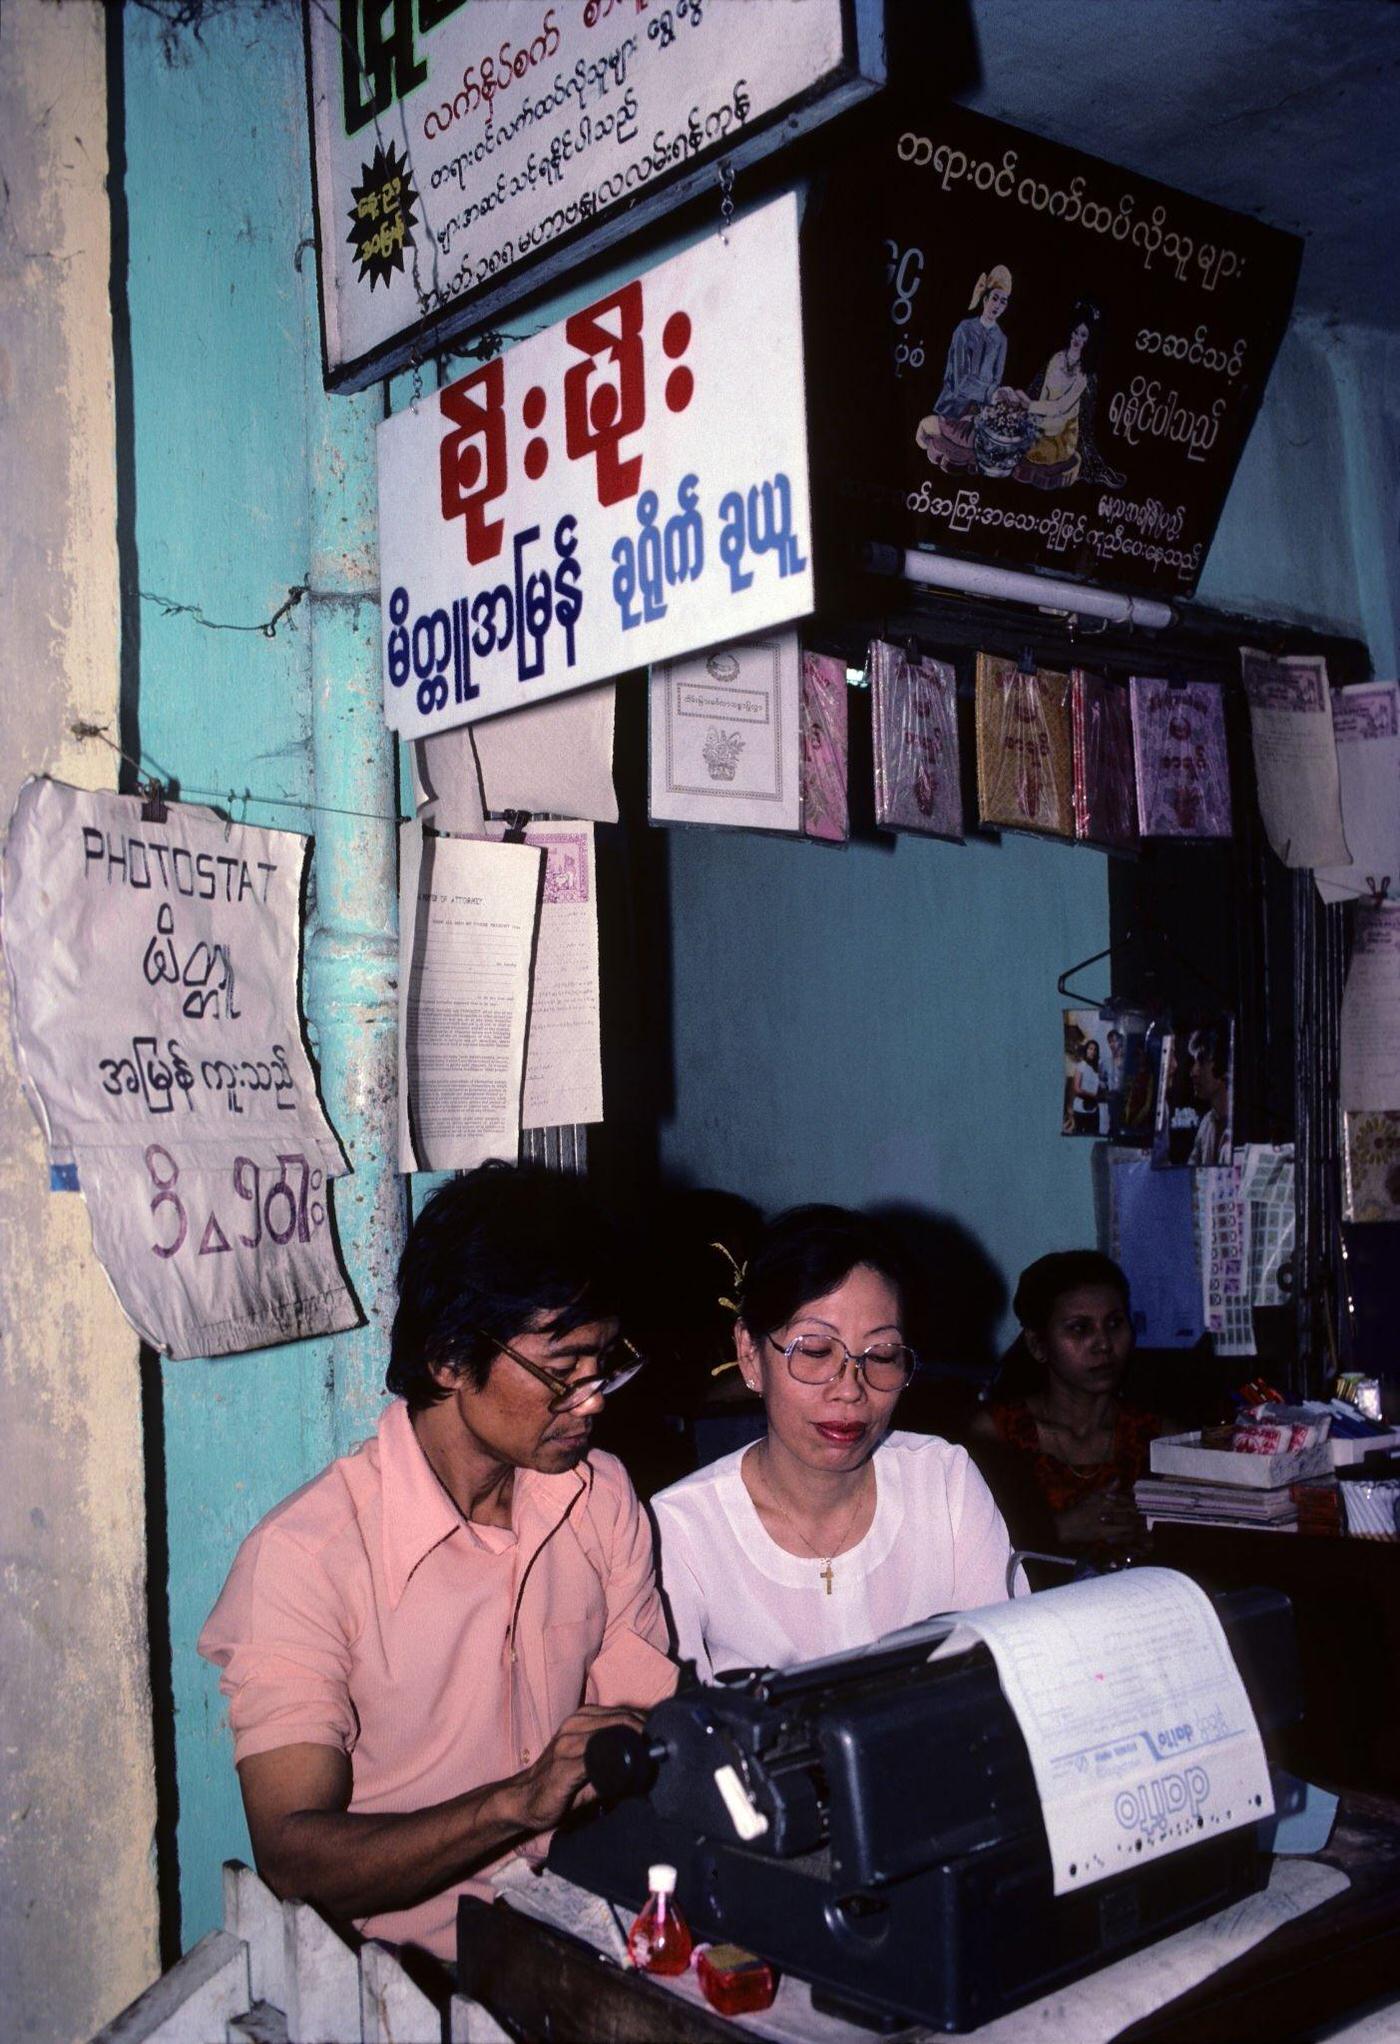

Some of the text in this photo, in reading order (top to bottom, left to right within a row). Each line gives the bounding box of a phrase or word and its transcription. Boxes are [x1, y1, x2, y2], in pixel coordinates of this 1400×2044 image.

[719, 473, 807, 594] ခုယူ
[82, 827, 278, 903] PHOTOSTAT
[99, 1037, 194, 1114] အမြန်
[1114, 1765, 1211, 1837] daito
